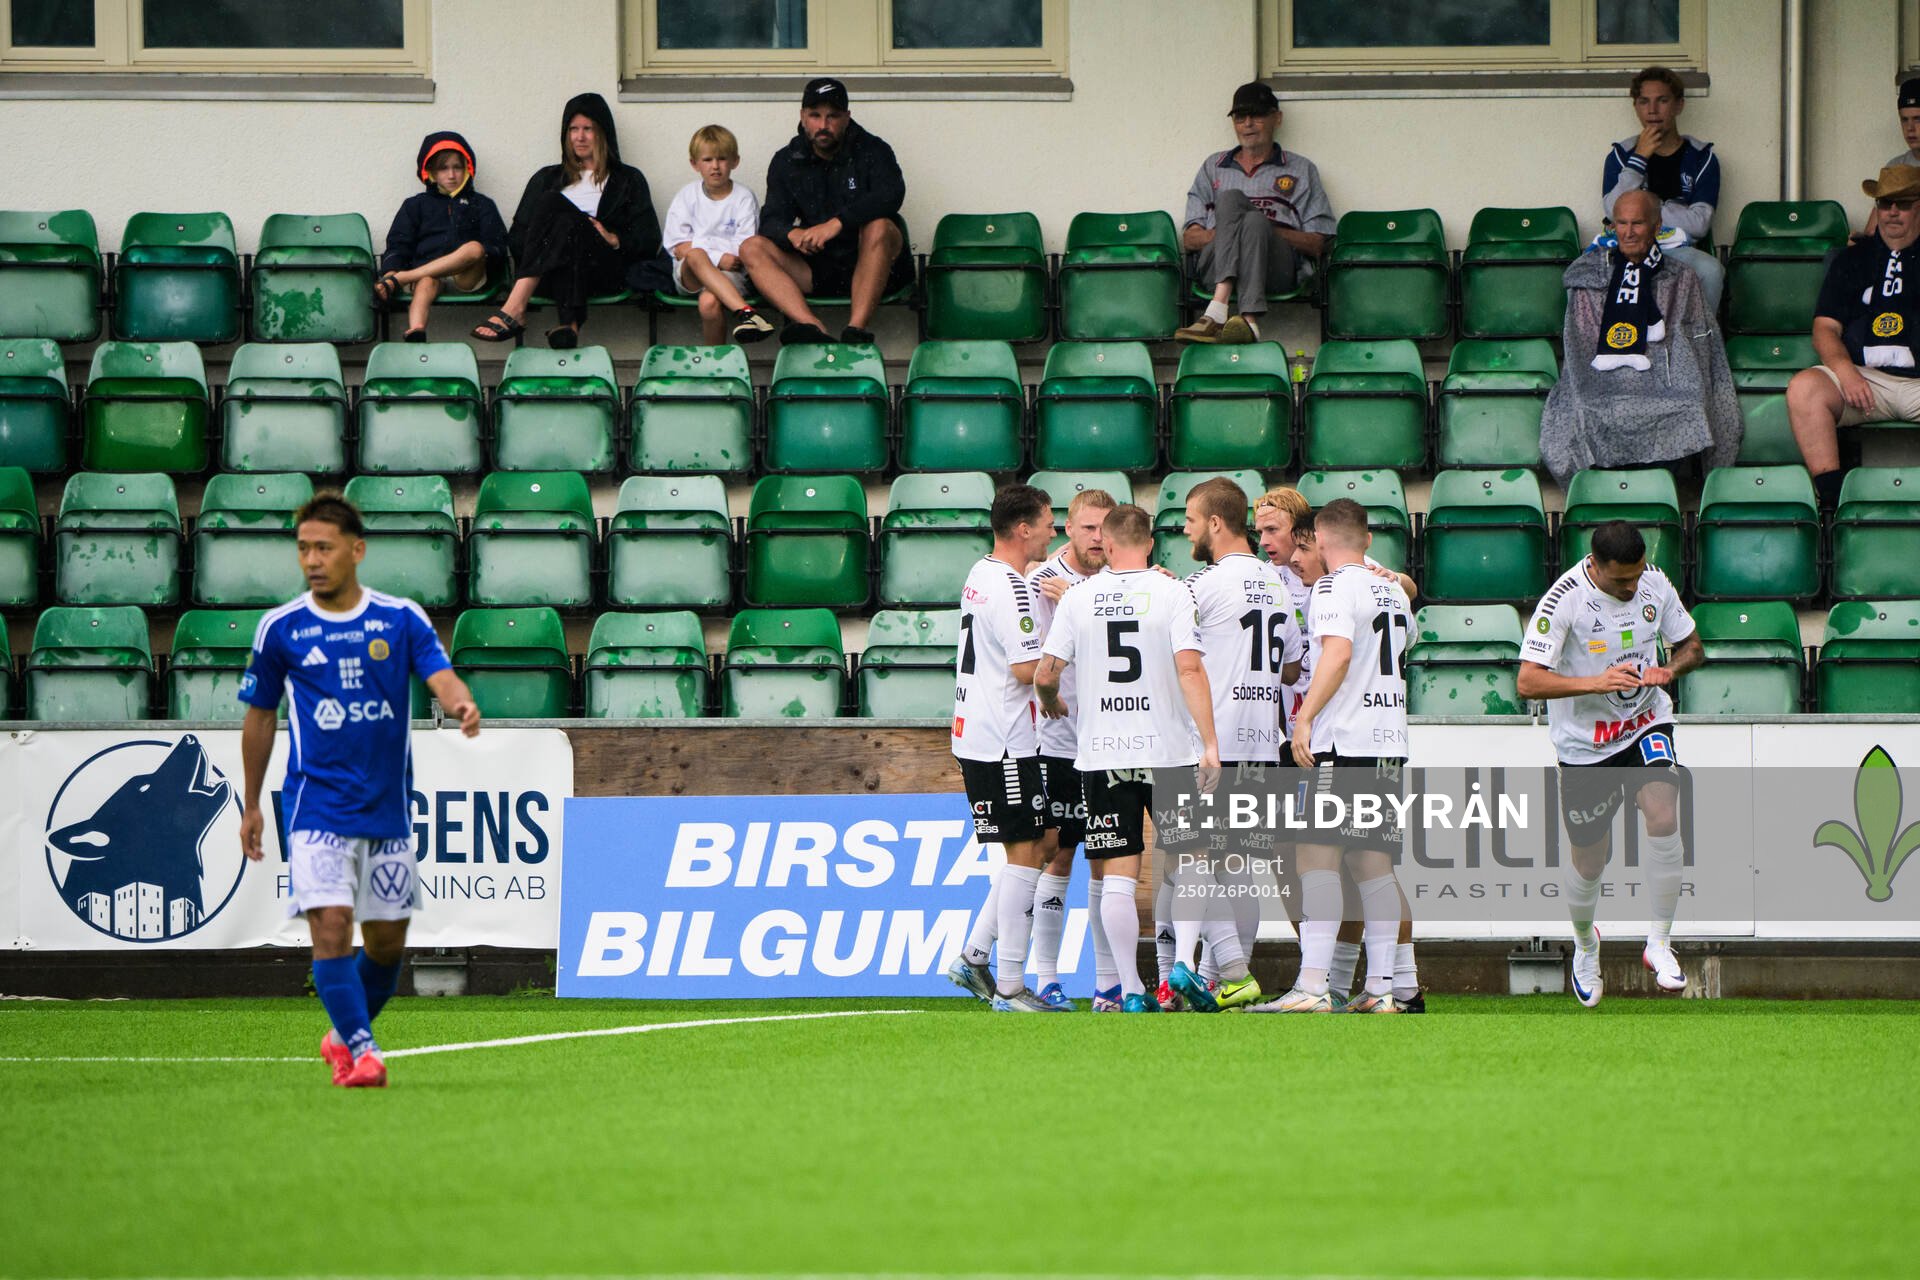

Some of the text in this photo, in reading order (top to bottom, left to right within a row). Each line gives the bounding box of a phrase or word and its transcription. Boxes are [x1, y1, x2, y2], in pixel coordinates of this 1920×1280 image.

[1243, 579, 1266, 591] pre
[1371, 584, 1391, 595] pre
[1094, 592, 1124, 606] pre
[1246, 592, 1274, 606] zero
[1376, 597, 1401, 610] zero
[1094, 605, 1134, 617] zero
[1239, 609, 1289, 674] 16
[1526, 639, 1553, 651] UNIBET
[1106, 620, 1143, 684] 5
[348, 700, 395, 723] SCA
[1101, 696, 1150, 713] MODIG
[1092, 735, 1158, 752] ERNST
[1086, 813, 1121, 830] XACT
[1156, 805, 1195, 825] XACT
[1086, 840, 1128, 851] ELLNESS
[1162, 831, 1200, 845] ELLNESS
[664, 819, 1008, 888] BIRSTA
[504, 875, 546, 900] AB
[1415, 882, 1696, 899] FASTIGETR
[577, 908, 1090, 978] BILGUMI
